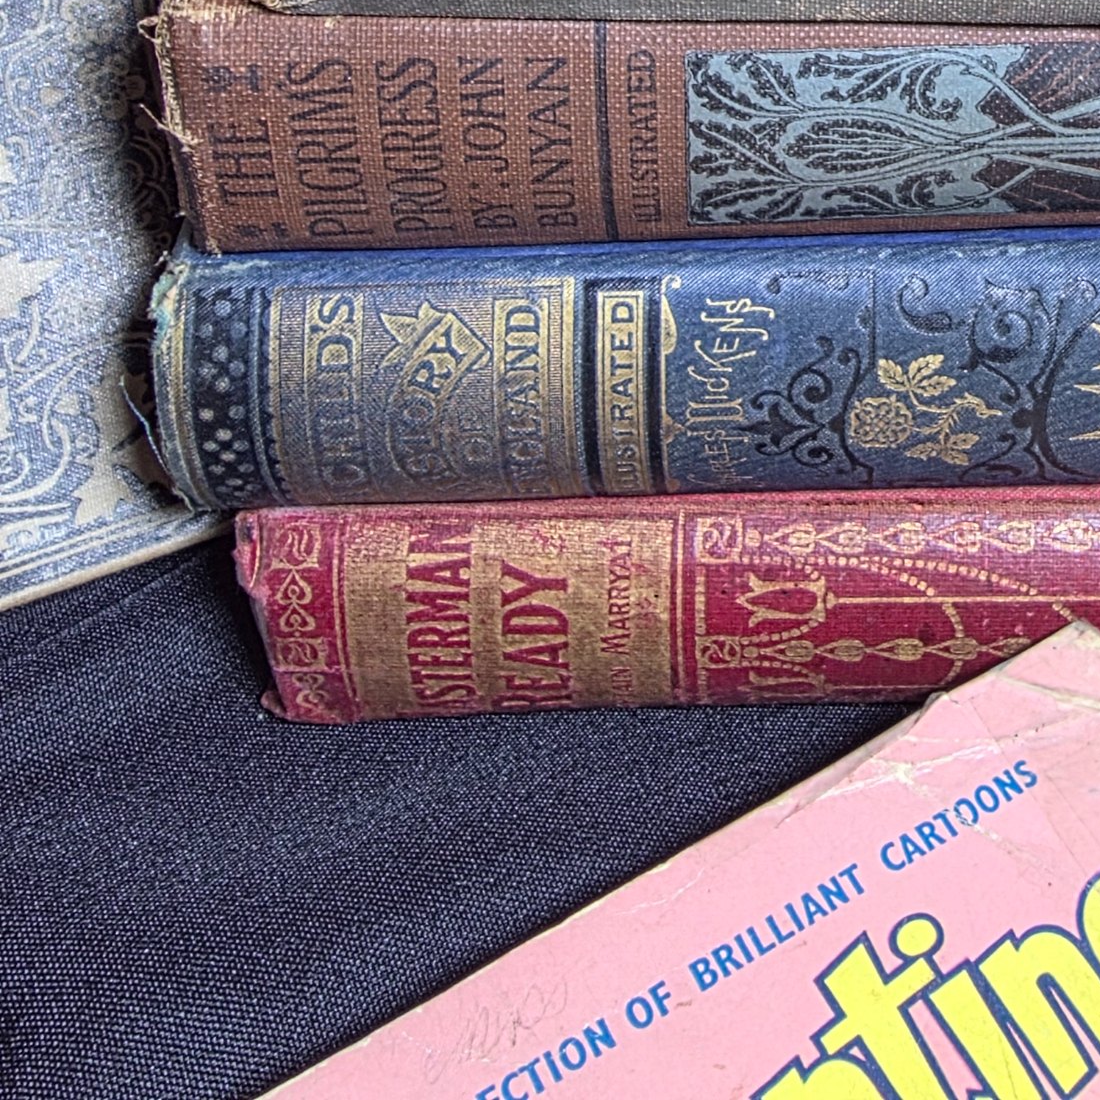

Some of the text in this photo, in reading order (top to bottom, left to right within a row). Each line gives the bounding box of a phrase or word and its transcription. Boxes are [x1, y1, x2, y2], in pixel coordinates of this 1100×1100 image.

[209, 117, 279, 203] THE
[375, 57, 456, 235] PROGRESS
[457, 56, 511, 172] JOHN
[524, 56, 580, 229] BUNYAN
[626, 48, 662, 224] ILLUSTRATED
[624, 979, 672, 1029] OF
[688, 862, 866, 992] BRILLIANT
[877, 759, 1039, 872] CARTOONS
